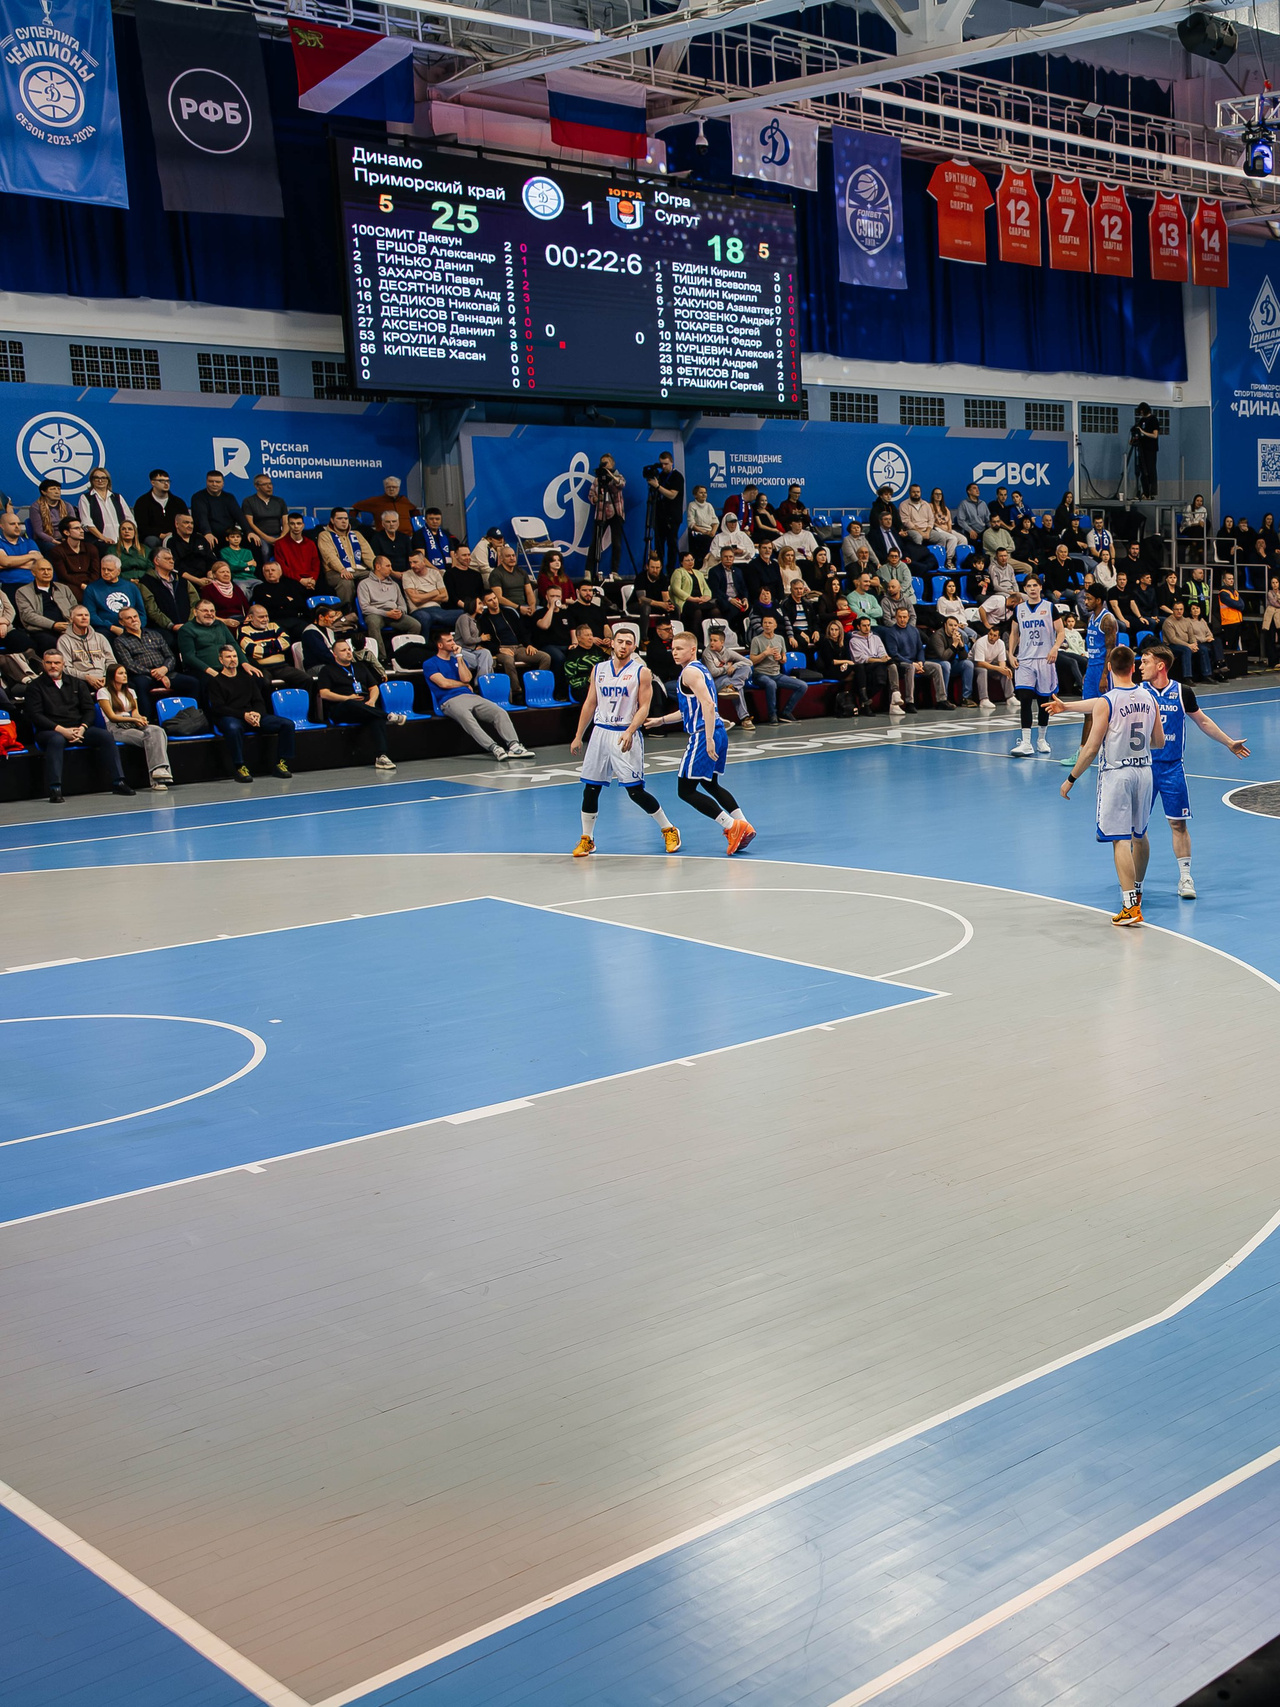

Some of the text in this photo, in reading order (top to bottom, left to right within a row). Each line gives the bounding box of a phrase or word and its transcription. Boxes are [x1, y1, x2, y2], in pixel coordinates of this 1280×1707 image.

[15, 26, 80, 52] СУПЕРЛИГА
[5, 40, 95, 82] ЧЕМПИОНЫ
[179, 97, 243, 126] РФБ
[15, 112, 97, 146] СЕЗОН 2023-2024
[352, 146, 423, 170] Динамо
[354, 167, 506, 201] Приморский край
[608, 187, 643, 200] ЮГРА
[654, 190, 691, 208] Югра
[378, 194, 394, 213] 5
[431, 200, 480, 234] 25
[581, 201, 593, 225] 1
[654, 209, 701, 228] Сургут
[857, 208, 882, 219] FONBET
[1006, 199, 1030, 227] 12
[1061, 208, 1075, 233] 7
[856, 218, 884, 239] СУПЕР
[1100, 214, 1123, 240] 12
[1158, 222, 1180, 247] 13
[418, 232, 463, 247] Дакаун
[1200, 228, 1221, 253] 14
[376, 240, 496, 263] ЕРШОВ Александр
[707, 235, 745, 264] 18
[758, 242, 770, 259] 5
[377, 253, 474, 273] ГИНЬКО Данил
[545, 244, 642, 275] 00:22:6
[378, 266, 484, 287] ЗАХАРОВ Павел
[672, 262, 747, 280] БУДИН Кирилл
[379, 279, 471, 298] ДЕСЯТНИКОВ
[672, 274, 762, 293] ТИШИН Всеволод
[380, 292, 500, 313] САДИКОВ Николай
[673, 285, 758, 303] САЛМИН Кирилл
[674, 296, 725, 311] ХАКУНОВ
[381, 306, 448, 322] ДЕНИСОВ
[674, 308, 738, 323] РОГОЗЕНКО
[382, 318, 496, 337] АКСЕНОВ Даниил
[675, 320, 760, 337] ТОКАРЕВ Сергей
[383, 331, 477, 349] КРОУЛИ Айзея
[675, 331, 763, 349] МАНИХИН Федор
[384, 344, 486, 362] КИПКЕЕВ Хасан
[676, 343, 774, 360] КУРЦЕВИЧ Алексей
[676, 355, 758, 371] ПЕЧКИН Андрей
[677, 366, 750, 380] ФЕТИСОВ Лев
[677, 378, 764, 393] ГРАШКИН Сергей
[1234, 390, 1274, 399] СПОРТИВНОЕ
[260, 439, 309, 455] Русская
[261, 452, 383, 470] Рыбопромышленная
[730, 453, 782, 464] ТЕЛЕВИДЕНИЕ
[262, 467, 323, 480] Компания
[730, 465, 763, 475] И РАДИО
[1008, 462, 1050, 487] ВСК
[731, 476, 805, 486] ПРИМОРСКОГО КРАЯ
[1022, 619, 1046, 629] ЮГРА
[1029, 630, 1040, 640] 23
[610, 701, 618, 713] 7
[1120, 702, 1151, 718] САЛМИН
[1129, 722, 1146, 752] 5
